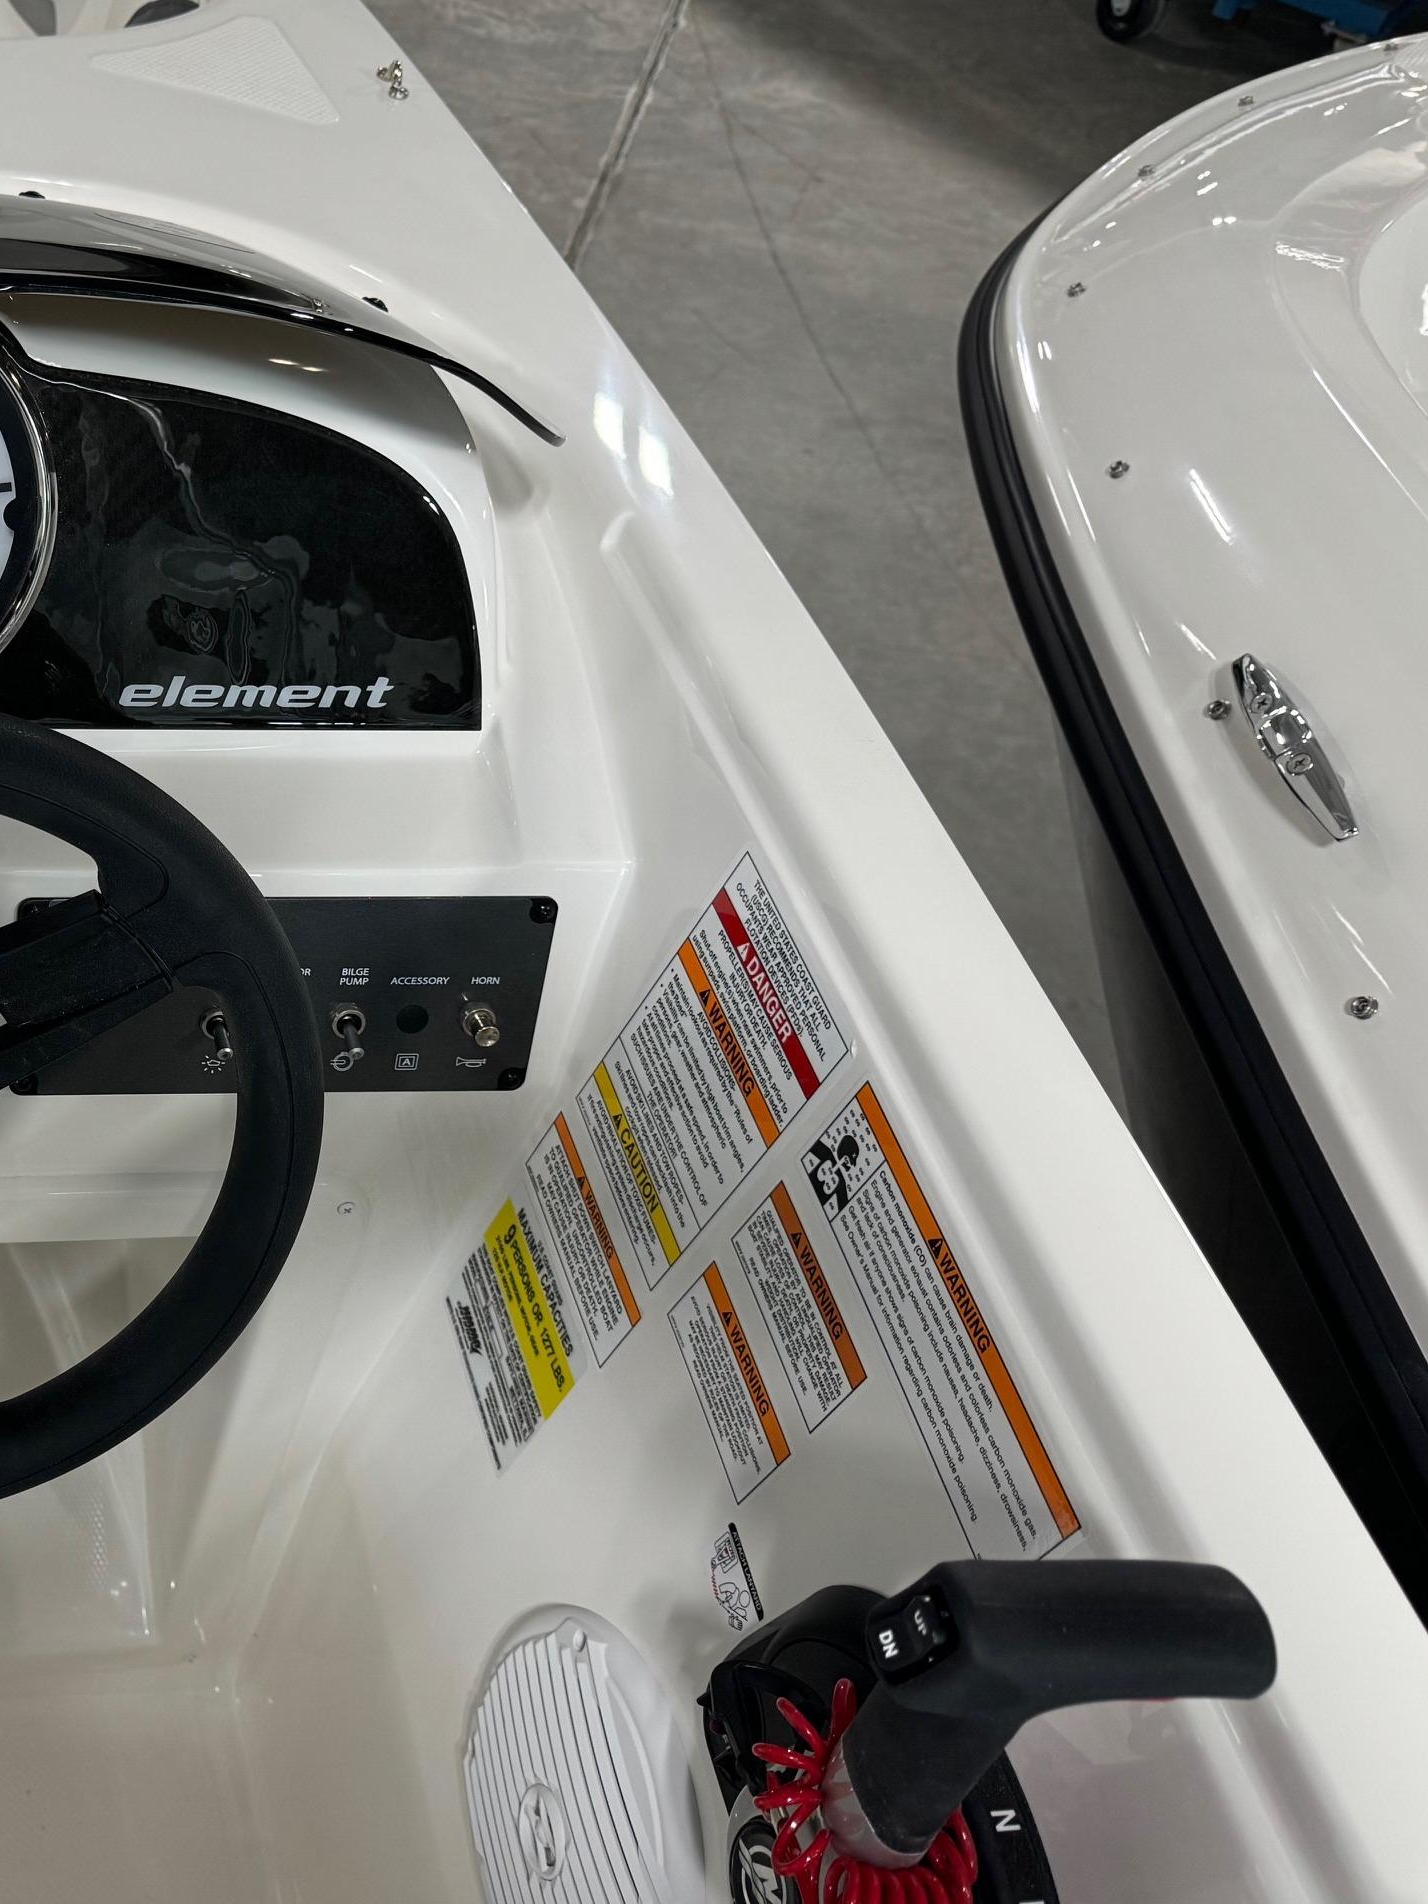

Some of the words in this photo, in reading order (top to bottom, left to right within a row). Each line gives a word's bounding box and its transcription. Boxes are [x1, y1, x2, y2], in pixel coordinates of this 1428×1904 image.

[119, 676, 394, 708] element
[339, 977, 369, 986] PUMP
[342, 968, 369, 976] BILGE
[390, 977, 450, 985] ACCESSORY
[471, 977, 500, 985] HORN
[735, 880, 763, 935] OCCUPANTS
[760, 932, 777, 963] WEAR
[774, 959, 801, 1012] APPROVED
[798, 1008, 826, 1062] PERSONAL
[743, 917, 770, 968] FLOTATION
[766, 963, 789, 1006] DEVICES
[785, 1002, 805, 1039] (PFDs).
[750, 892, 769, 927] (USCG)
[765, 922, 800, 989] RECOMMENDS
[796, 985, 813, 1015] THAT
[808, 1009, 821, 1032] ALL
[753, 878, 765, 900] THE
[762, 896, 781, 932] UNITED
[778, 928, 798, 965] STATES
[795, 962, 814, 997] COAST
[810, 993, 831, 1031] GUARD
[691, 932, 706, 959] using
[701, 954, 722, 995] sunpads,
[718, 989, 732, 1016] swim
[728, 1011, 749, 1054] platform,
[745, 1048, 753, 1062] or
[749, 1057, 771, 1099] boarding
[766, 1094, 784, 1129] ladder.
[698, 928, 717, 964] Shut-off
[712, 958, 734, 1001] engine(s)
[729, 994, 744, 1022] when
[739, 1017, 753, 1041] near
[748, 1036, 774, 1086] swimmers,
[769, 1080, 783, 1105] prior
[778, 1100, 788, 1116] to
[717, 928, 750, 994] PROPELLER(S)
[746, 988, 759, 1012] MAY
[754, 1006, 773, 1042] CAUSE
[769, 1037, 792, 1082] SERIOUS
[728, 970, 747, 1006] INJURY
[742, 1001, 753, 1019] OR
[749, 1014, 768, 1051] DEATH.
[745, 955, 792, 1044] DANGER
[697, 1009, 712, 1039] AVOID
[708, 1035, 736, 1093] COLLISIONS-
[707, 1001, 755, 1098] WARNING
[619, 1125, 658, 1214] CAUTION
[503, 1221, 517, 1247] 9
[555, 1141, 571, 1178] ATTACH
[567, 1176, 580, 1204] SHUT
[577, 1201, 591, 1233] DOWN
[588, 1230, 604, 1269] SWITCH
[601, 1267, 622, 1316] LANYARD
[584, 1189, 613, 1261] WARNING
[847, 1204, 858, 1221] Get
[854, 1219, 866, 1241] fresh
[856, 1195, 866, 1213] and
[863, 1211, 874, 1230] lack
[871, 1229, 879, 1240] of
[875, 1238, 907, 1302] consciousness.
[862, 1239, 871, 1251] air
[509, 1237, 536, 1304] PERSONS
[516, 1206, 545, 1275] MAXIMUM
[538, 1271, 575, 1358] CAPACITIES
[867, 1249, 874, 1258] if
[870, 1256, 887, 1287] anyone
[878, 1169, 897, 1202] Carbon
[893, 1200, 917, 1245] monoxide
[913, 1243, 927, 1267] (CO)
[923, 1265, 935, 1284] can
[931, 1282, 948, 1311] cause
[943, 1309, 958, 1333] brain
[954, 1333, 976, 1371] damage
[971, 1370, 981, 1382] or
[976, 1381, 995, 1412] death.
[530, 1300, 543, 1327] OR
[766, 1208, 784, 1246] QUALIFIED
[782, 1246, 801, 1286] OPERATOR
[798, 1286, 806, 1299] TO
[803, 1298, 811, 1311] BE
[809, 1311, 815, 1322] IN
[813, 1321, 831, 1360] CONTROL
[829, 1359, 837, 1372] AT
[834, 1371, 843, 1388] ALL
[798, 1245, 844, 1340] WARNING
[883, 1286, 899, 1314] shows
[895, 1312, 909, 1336] signs
[937, 1252, 992, 1354] WARNING
[539, 1325, 555, 1361] 1277
[549, 1356, 566, 1393] LBS.
[728, 1324, 770, 1417] WARNING
[839, 1213, 850, 1232] See
[846, 1230, 865, 1265] Owner's
[861, 1263, 879, 1295] Manual
[875, 1294, 884, 1307] for
[880, 1306, 905, 1354] information
[900, 1354, 923, 1397] regarding
[919, 1396, 937, 1429] carbon
[933, 1428, 958, 1474] monoxide
[861, 1188, 876, 1213] Signs
[872, 1211, 880, 1222] of
[876, 1220, 893, 1251] carbon
[889, 1248, 911, 1290] monoxide
[907, 1289, 930, 1332] poisoning
[926, 1330, 945, 1363] include
[940, 1362, 961, 1399] nausea,
[956, 1397, 983, 1446] headache,
[977, 1445, 1004, 1492] dizziness,
[998, 1492, 1031, 1551] drowsiness,
[870, 1178, 887, 1210] Engine
[883, 1207, 894, 1226] and
[890, 1223, 913, 1265] generator
[909, 1264, 928, 1298] exhaust
[924, 1297, 945, 1335] contains
[941, 1334, 963, 1374] odorless
[958, 1373, 972, 1392] and
[967, 1391, 991, 1434] colorless
[986, 1433, 1007, 1468] carbon
[1002, 1468, 1029, 1516] monoxide
[1024, 1517, 1040, 1539] gas.
[905, 1335, 914, 1346] of
[909, 1345, 927, 1376] carbon
[922, 1375, 946, 1418] monoxide
[941, 1417, 967, 1464] poisoning.
[733, 1531, 746, 1567] ATTACH
[744, 1568, 762, 1611] LANYARD
[879, 1629, 898, 1659] DN
[990, 1809, 1021, 1833] N
